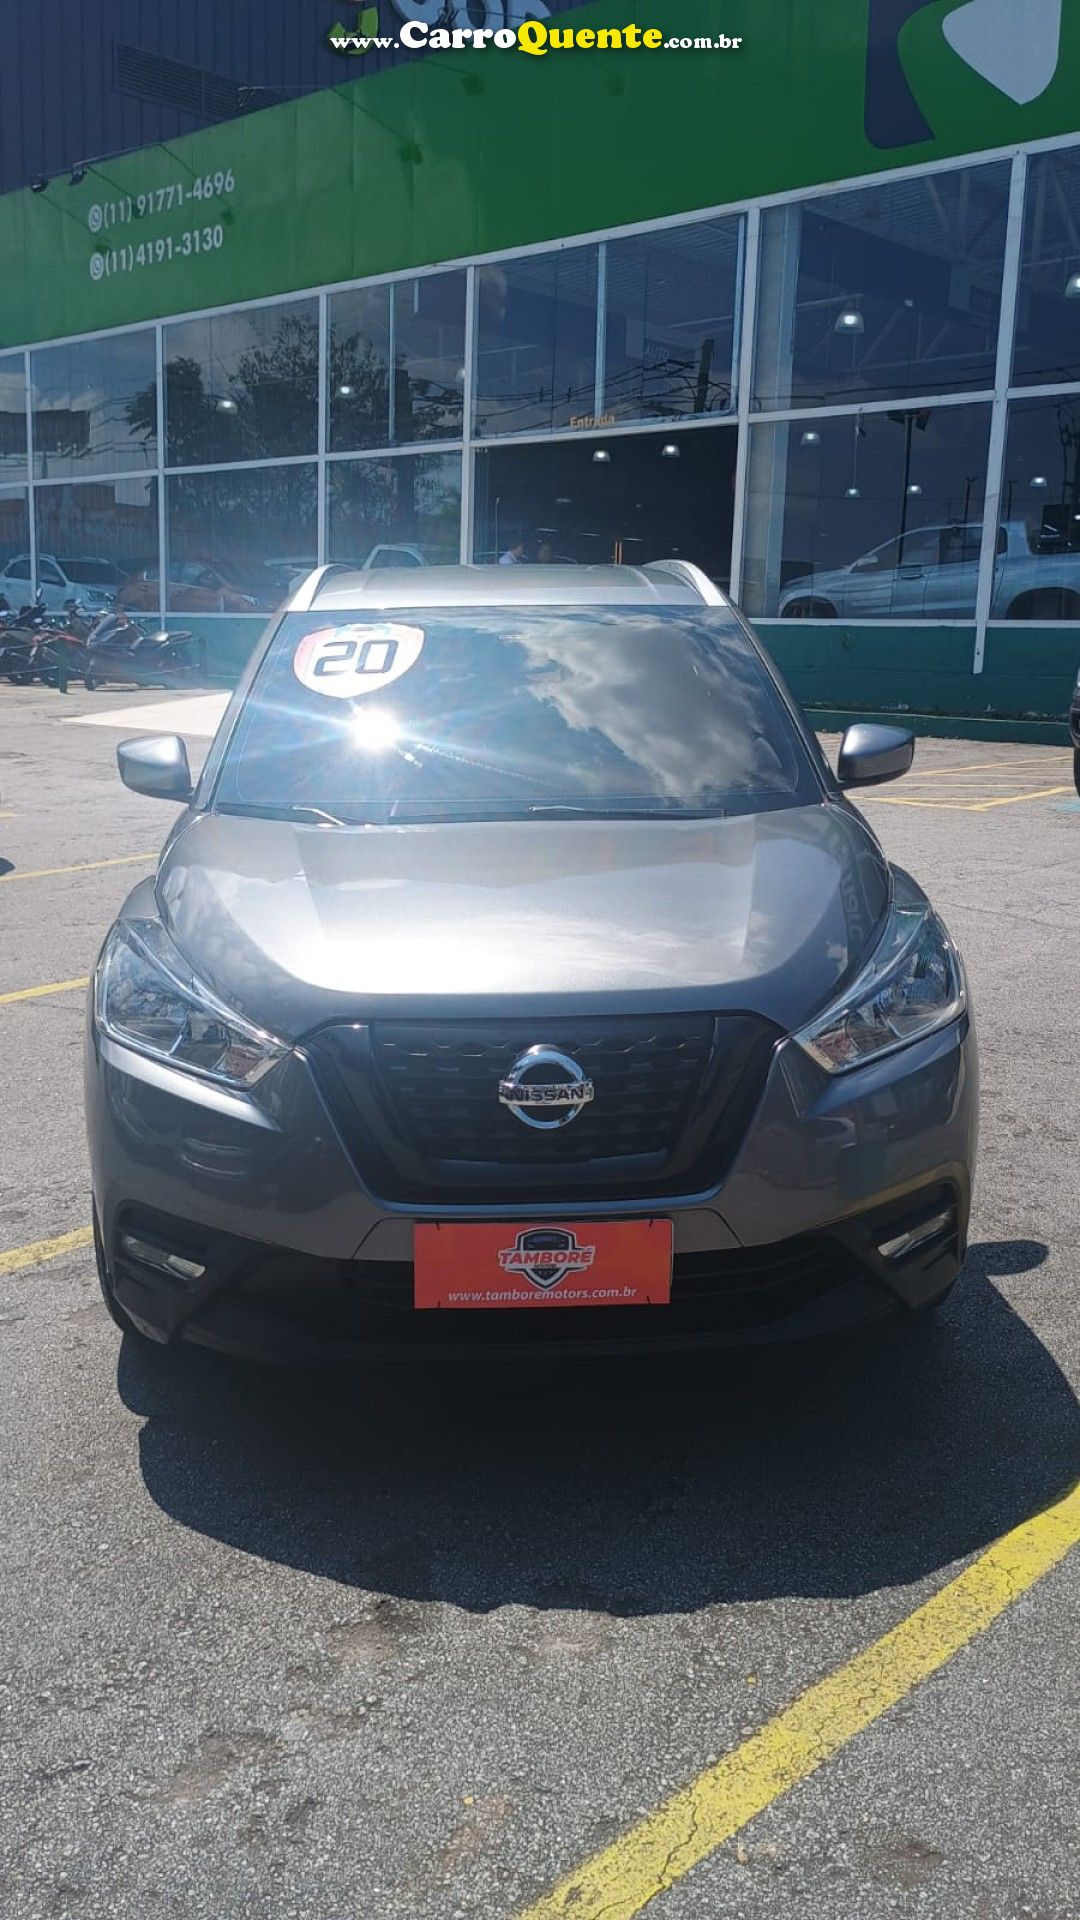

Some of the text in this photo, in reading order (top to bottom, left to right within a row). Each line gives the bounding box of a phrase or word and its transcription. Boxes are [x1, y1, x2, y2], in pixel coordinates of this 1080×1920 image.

[568, 412, 616, 429] Entrada
[313, 639, 399, 677] 20
[509, 1083, 585, 1102] NISSAN
[499, 1247, 594, 1265] TAMBORÉ
[448, 1286, 638, 1302] www.tamboremotors.com.br
